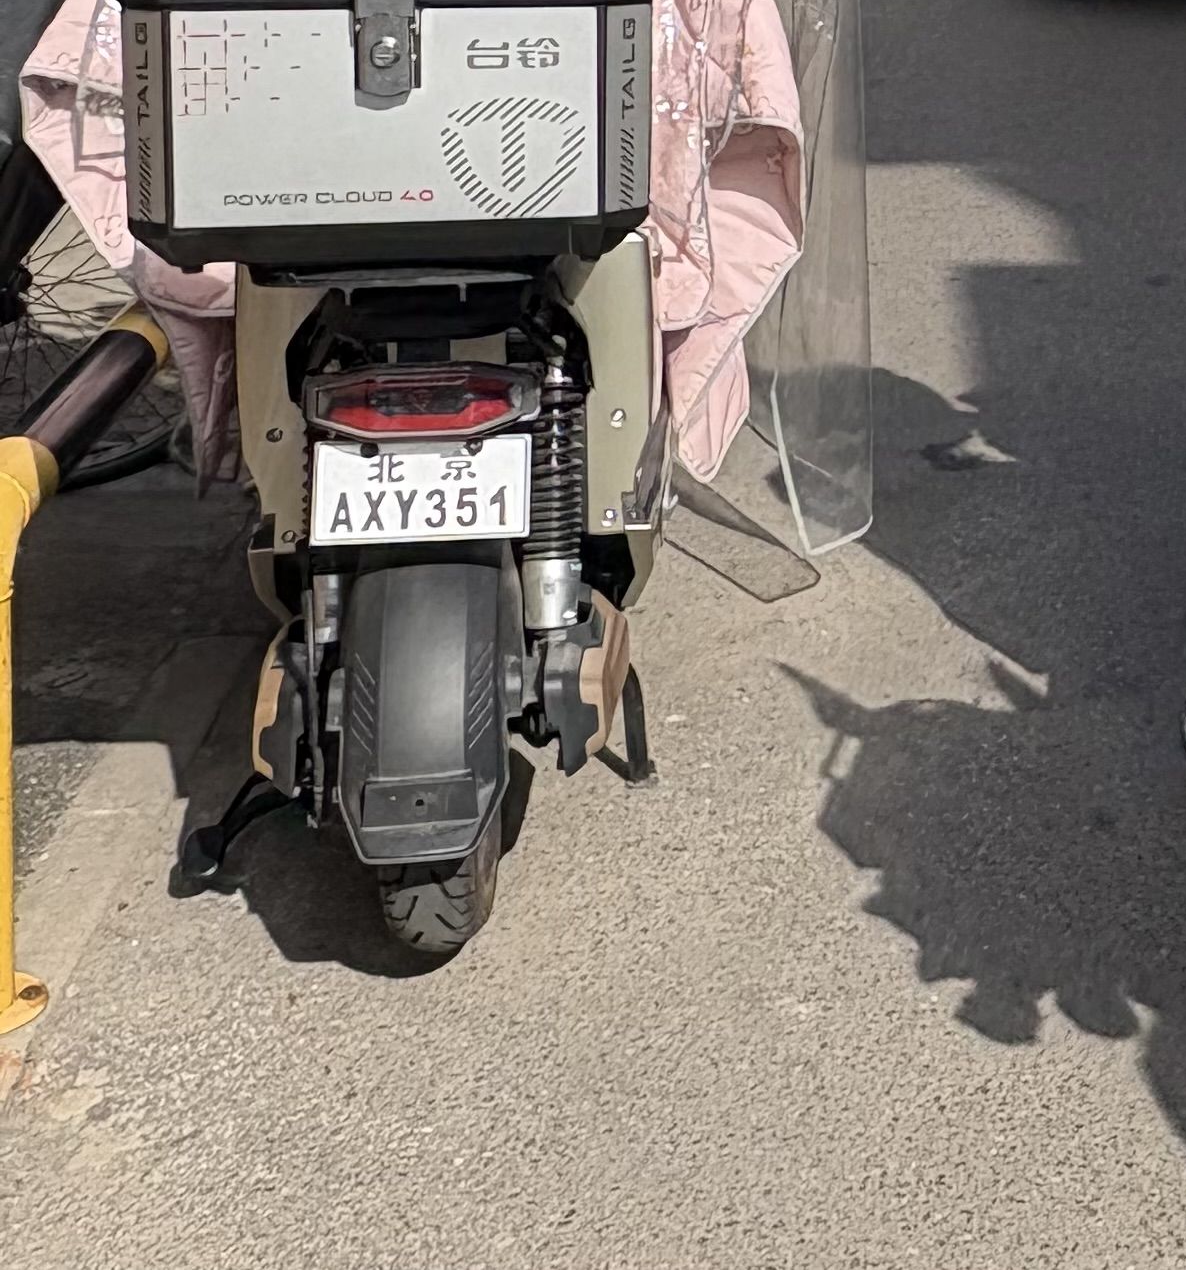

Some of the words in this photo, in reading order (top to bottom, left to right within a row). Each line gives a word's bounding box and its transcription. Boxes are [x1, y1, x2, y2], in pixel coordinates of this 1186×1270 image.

[466, 37, 560, 70] 台铃
[223, 193, 308, 207] POWER
[315, 190, 393, 204] CLOUD
[367, 452, 477, 484] 北京
[329, 485, 508, 534] AXY351
